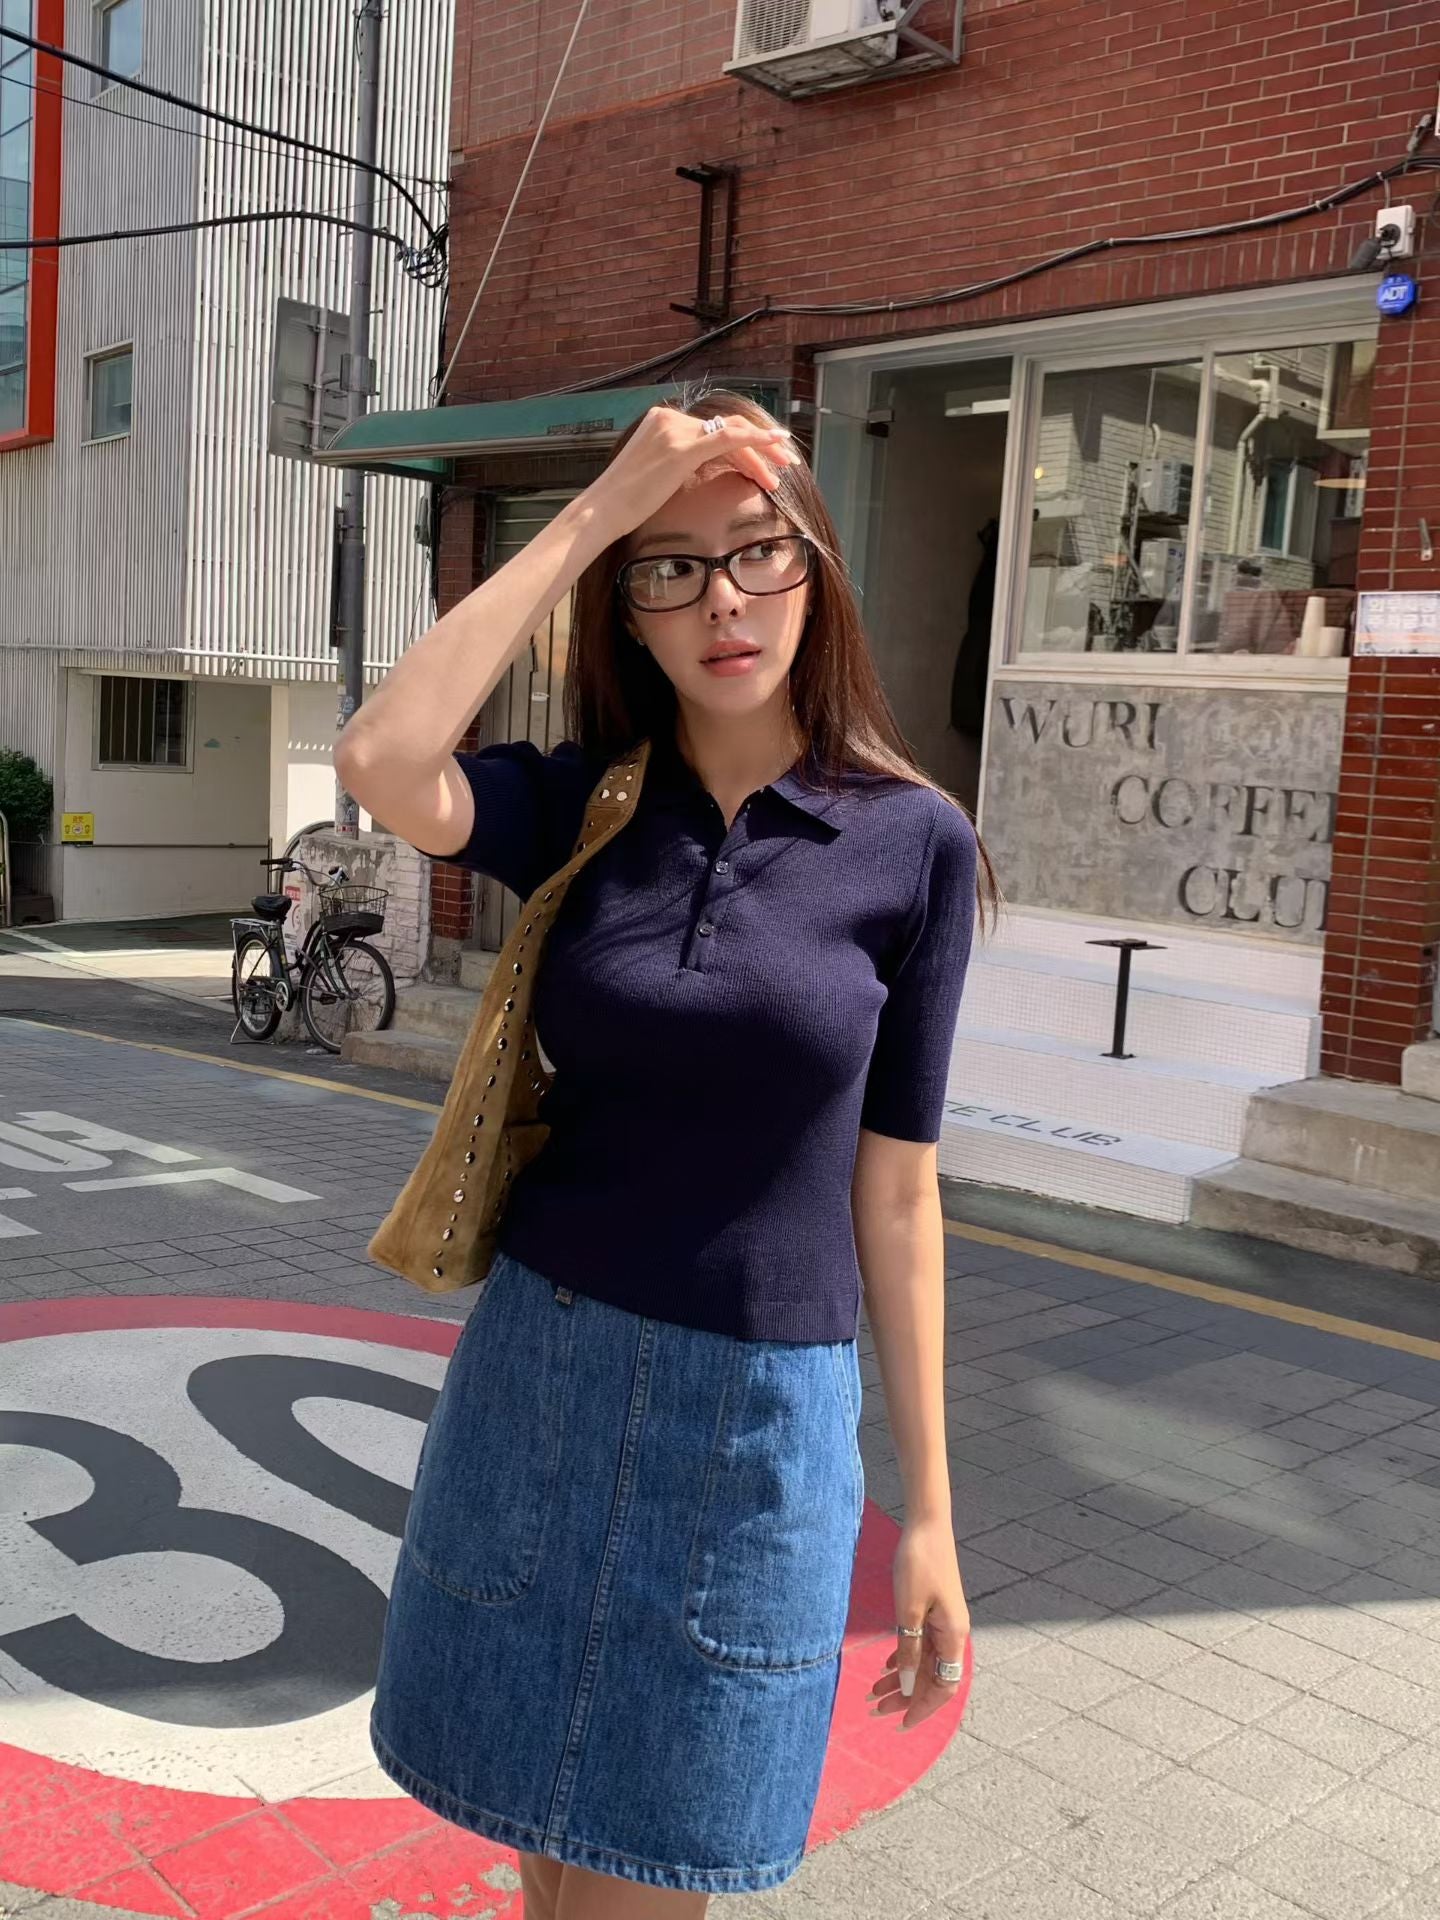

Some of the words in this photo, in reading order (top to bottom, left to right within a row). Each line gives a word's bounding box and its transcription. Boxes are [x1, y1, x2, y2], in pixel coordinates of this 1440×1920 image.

[1382, 286, 1407, 302] ADT
[1000, 697, 1162, 750] WURI
[1110, 774, 1338, 844] COFFE
[1177, 864, 1330, 931] CLU
[989, 1114, 1122, 1146] CLUB
